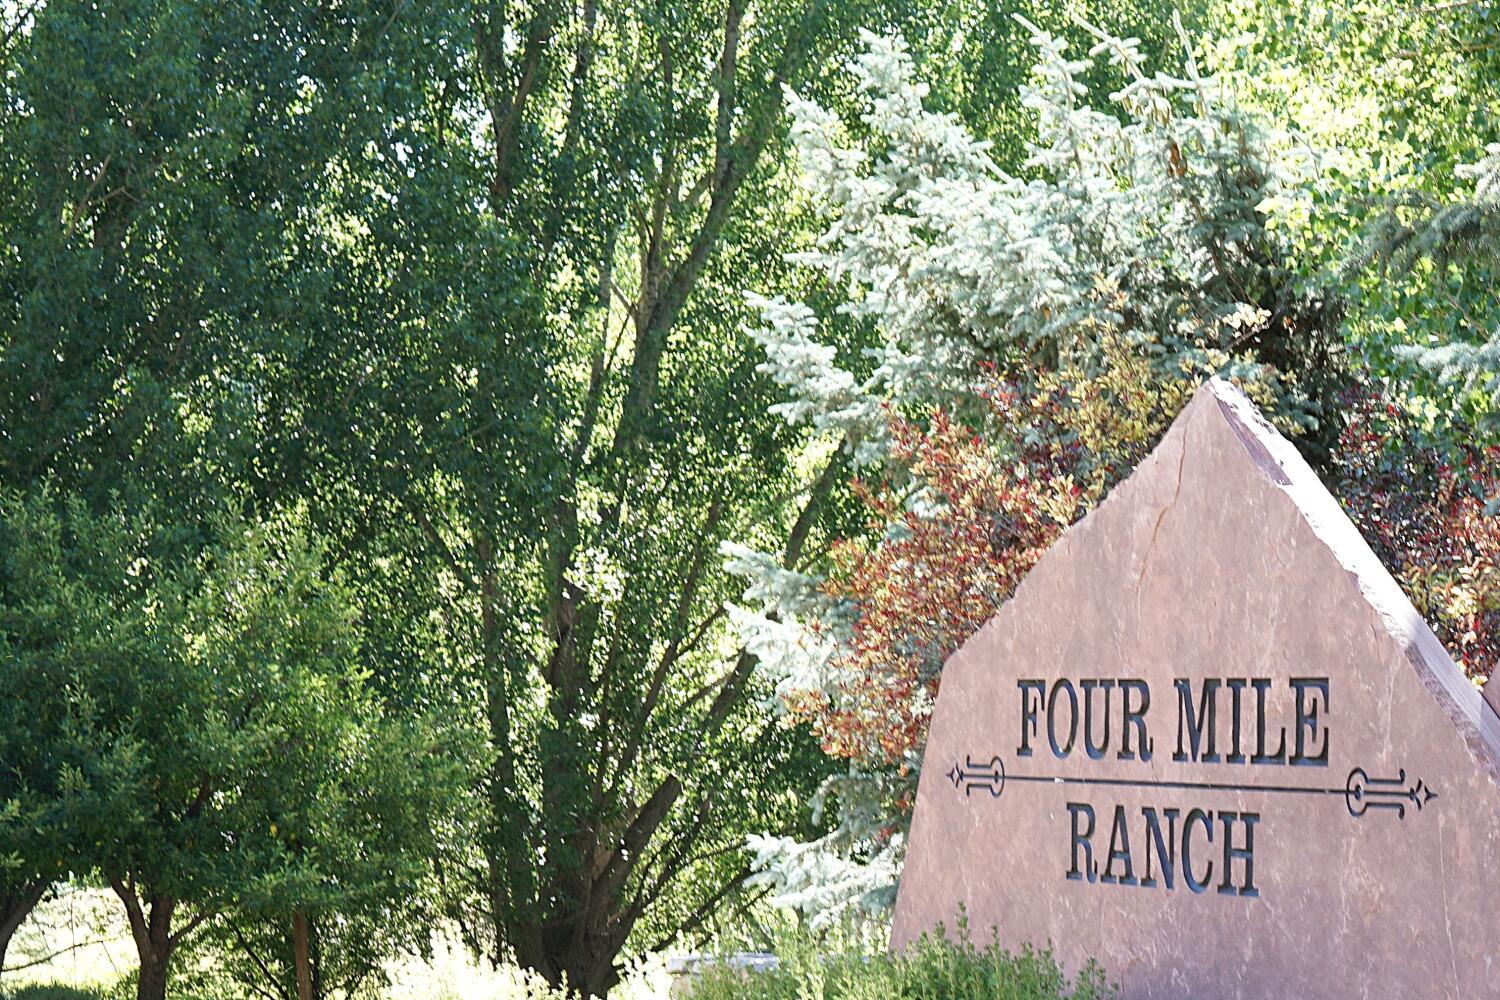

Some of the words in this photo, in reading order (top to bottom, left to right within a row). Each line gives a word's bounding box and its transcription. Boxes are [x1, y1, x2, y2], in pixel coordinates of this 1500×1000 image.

[1016, 677, 1154, 762] FOUR
[1172, 676, 1330, 767] MILE
[1065, 801, 1261, 898] RANCH
